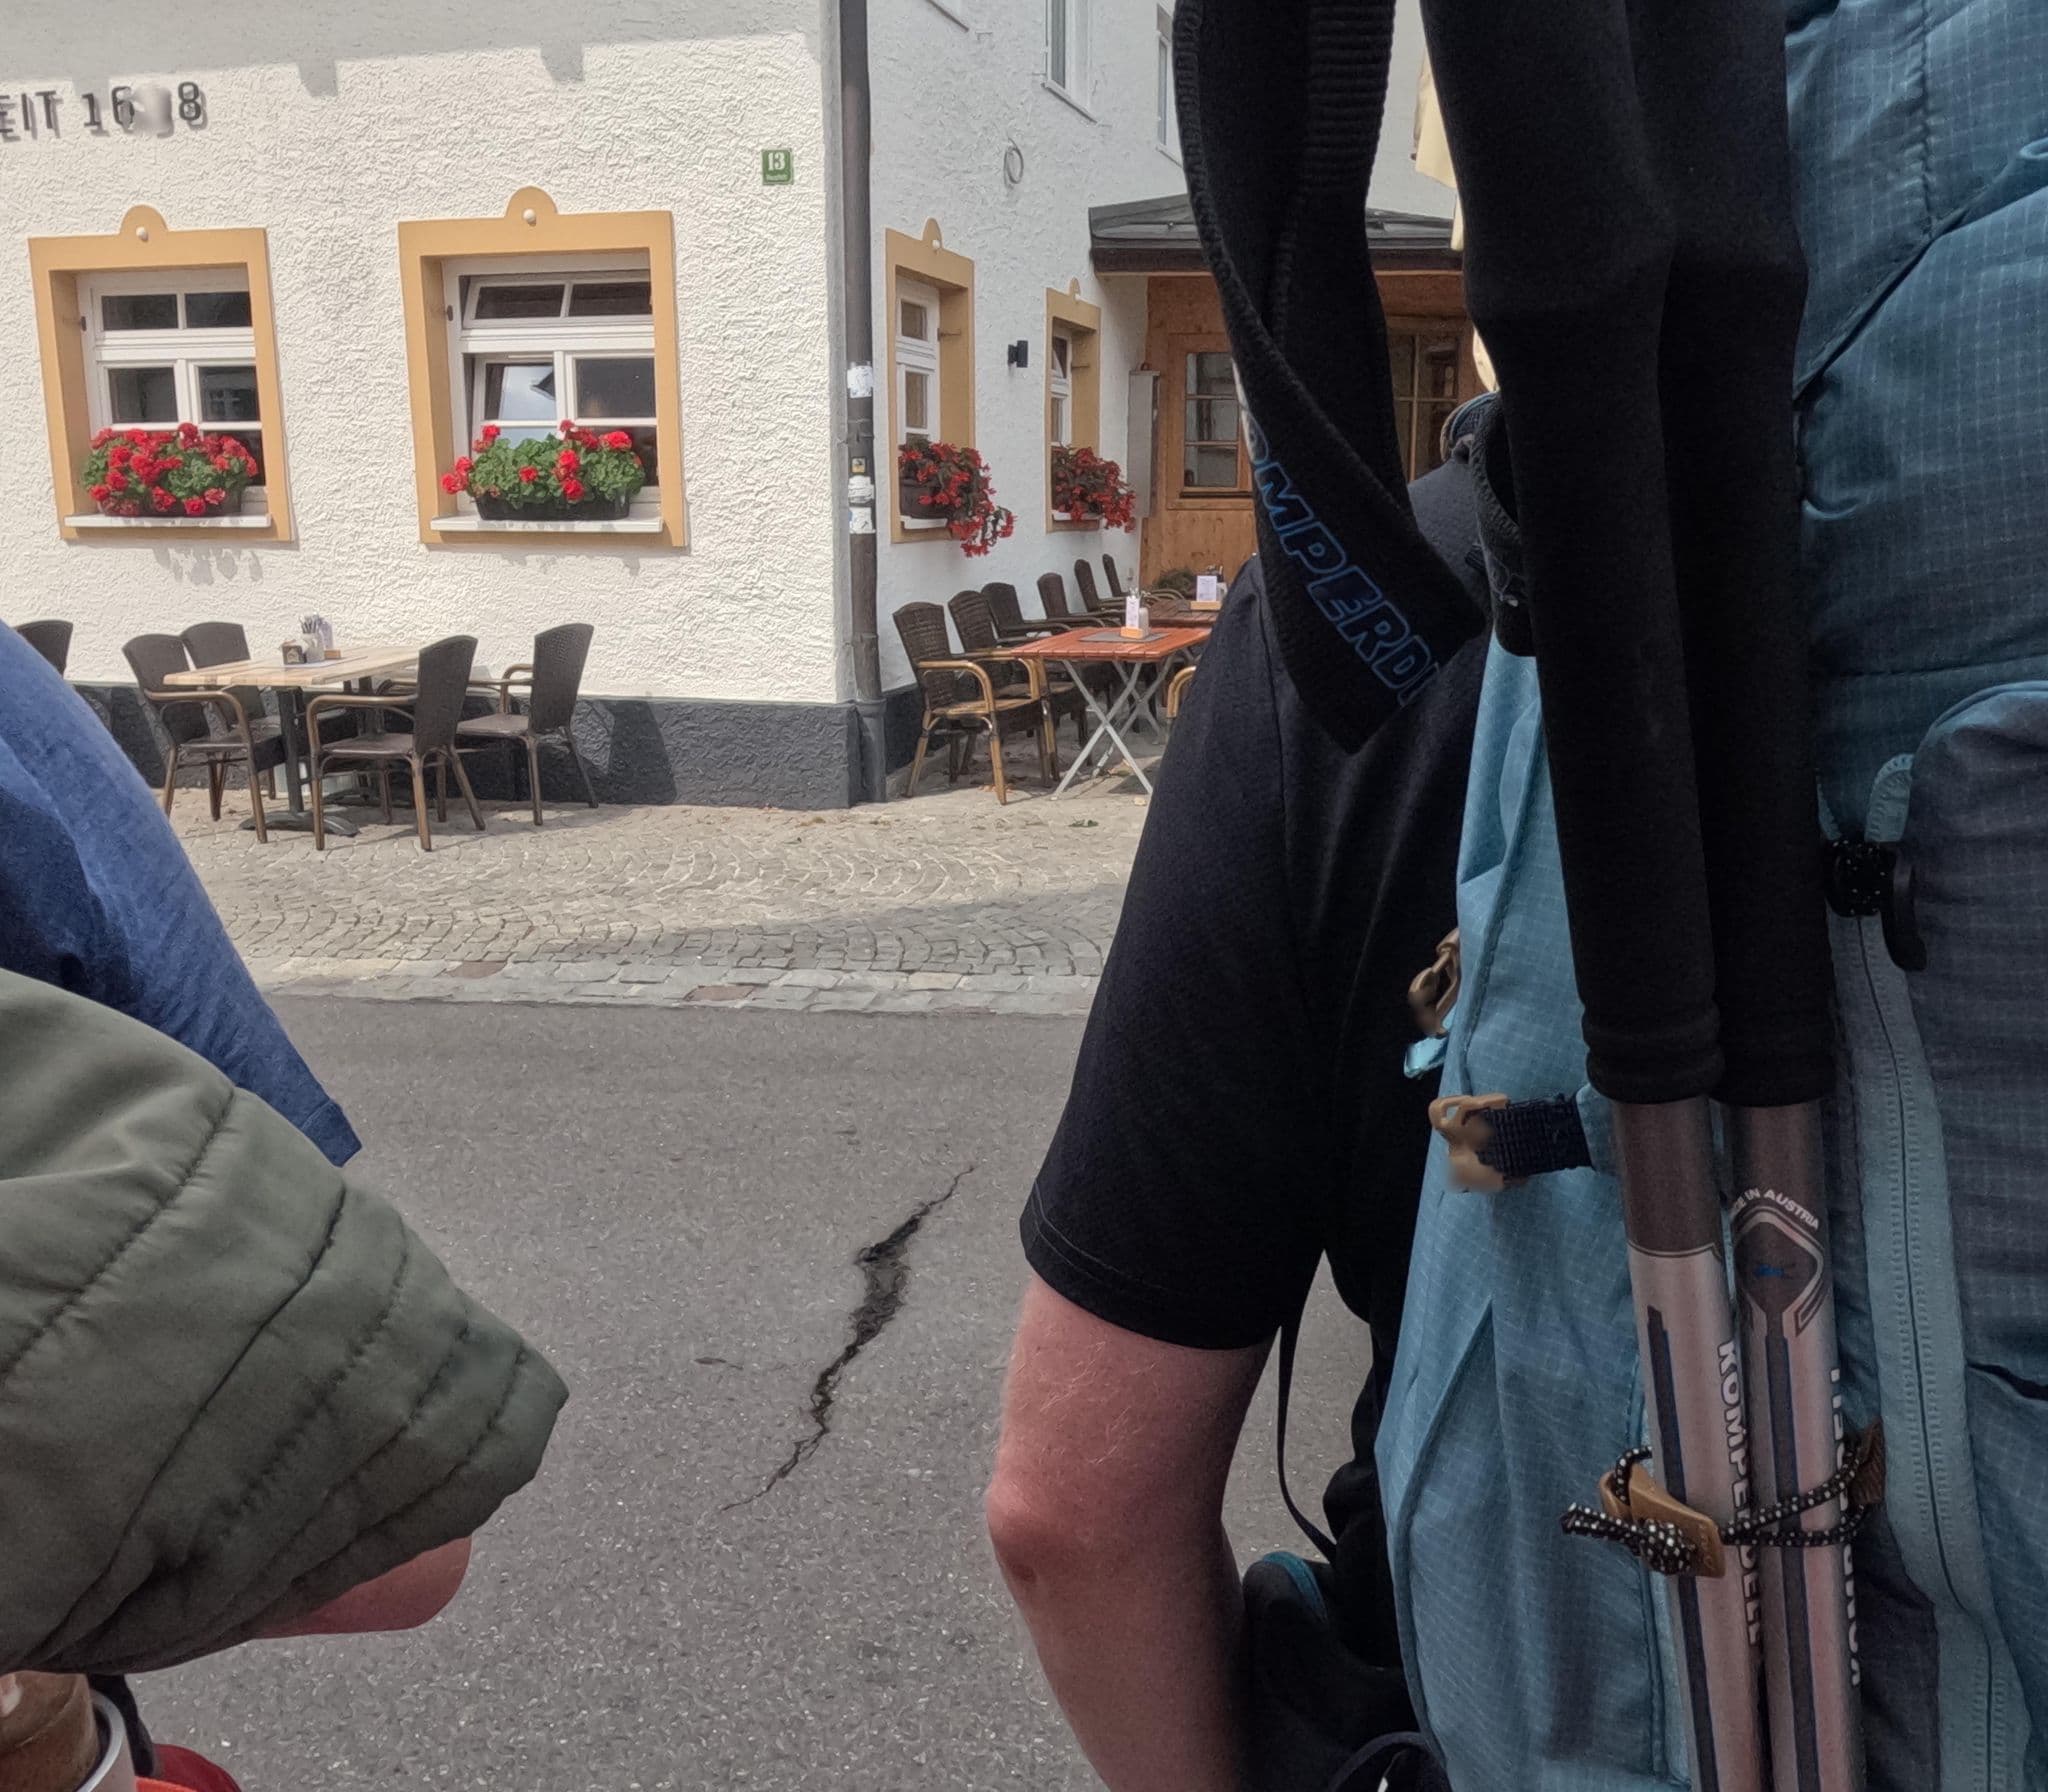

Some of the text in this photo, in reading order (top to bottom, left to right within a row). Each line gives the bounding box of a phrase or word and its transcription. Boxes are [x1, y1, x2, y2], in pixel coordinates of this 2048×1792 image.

[81, 81, 202, 127] 168
[767, 152, 786, 171] 13
[1763, 1188, 1820, 1231] AUSTRIA
